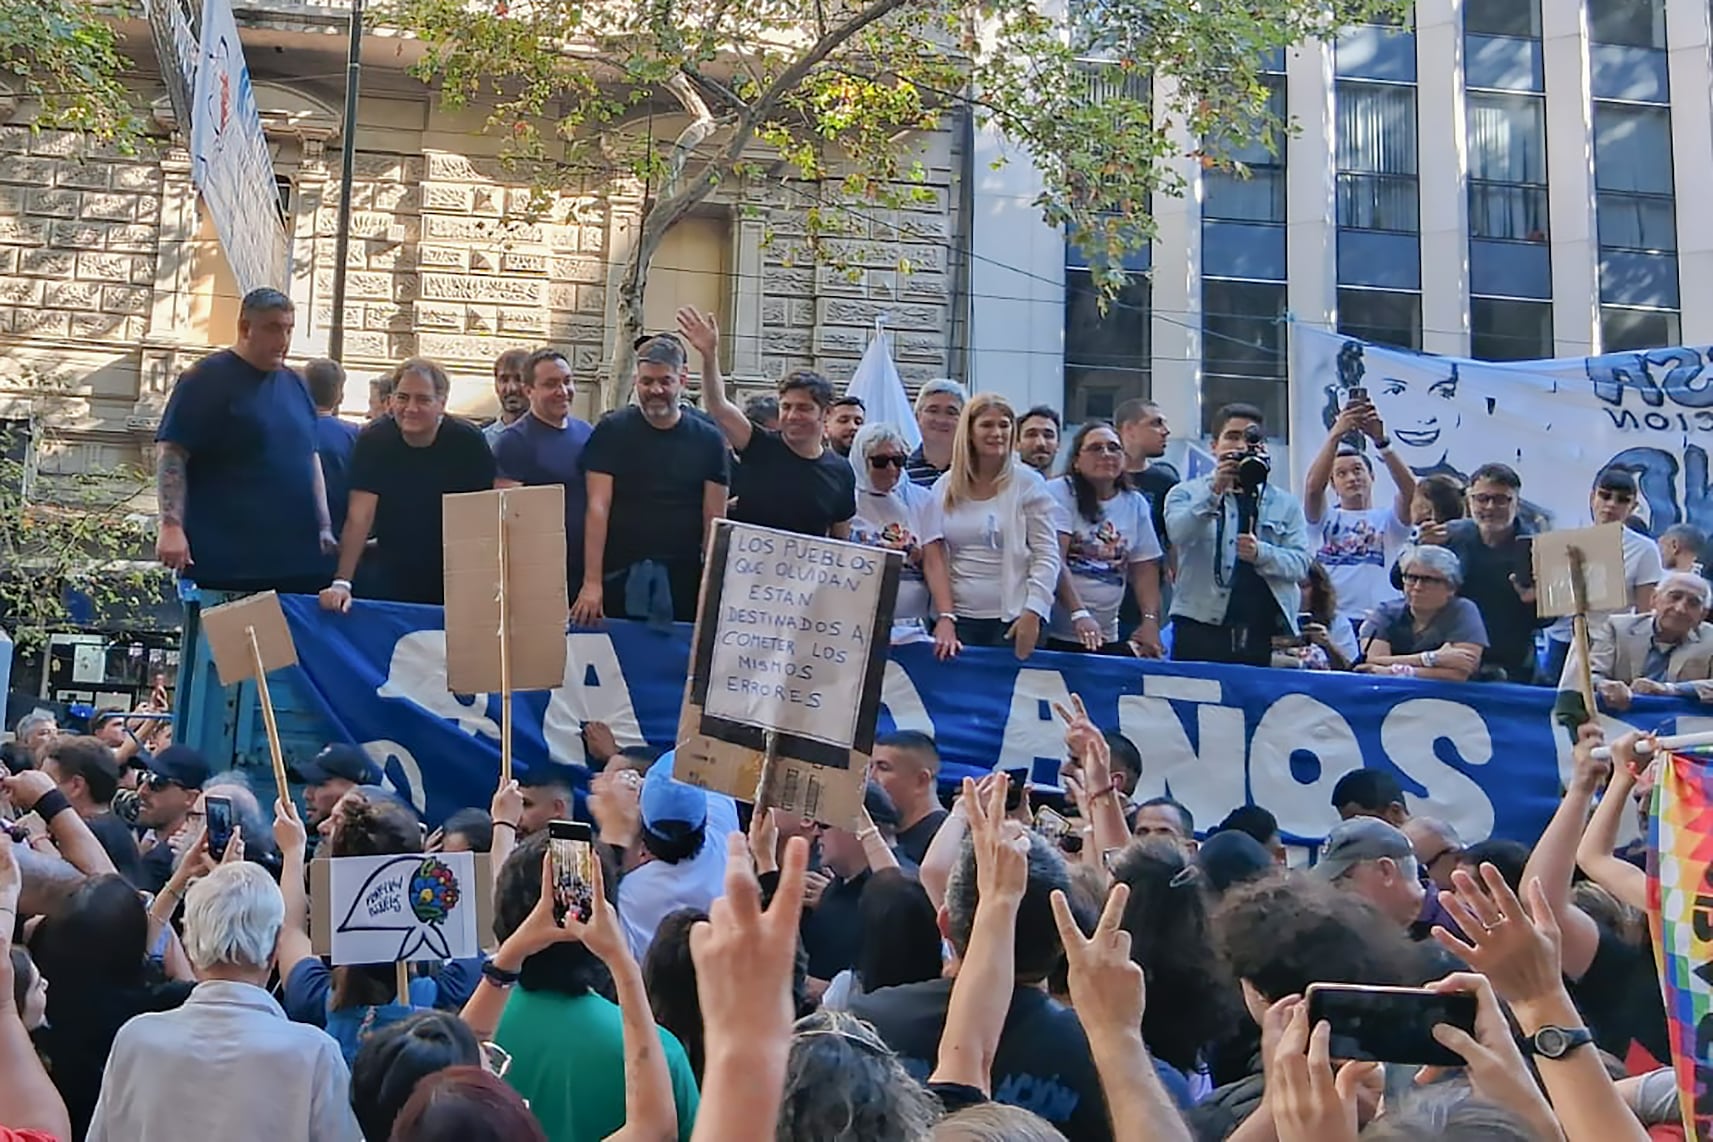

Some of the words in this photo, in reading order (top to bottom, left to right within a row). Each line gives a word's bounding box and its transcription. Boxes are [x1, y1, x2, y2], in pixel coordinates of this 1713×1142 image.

[737, 537, 775, 554] LOS
[784, 540, 878, 576] PUEBLOS
[735, 557, 764, 576] QUE
[775, 562, 861, 592] OLVIDAN
[749, 585, 813, 606] ESTAN
[721, 630, 796, 656] COMETER
[812, 642, 848, 664] LOS
[851, 624, 865, 645] A
[738, 656, 814, 680] MISMOS
[727, 676, 822, 709] ERRORES
[992, 667, 1496, 845] AÑOS
